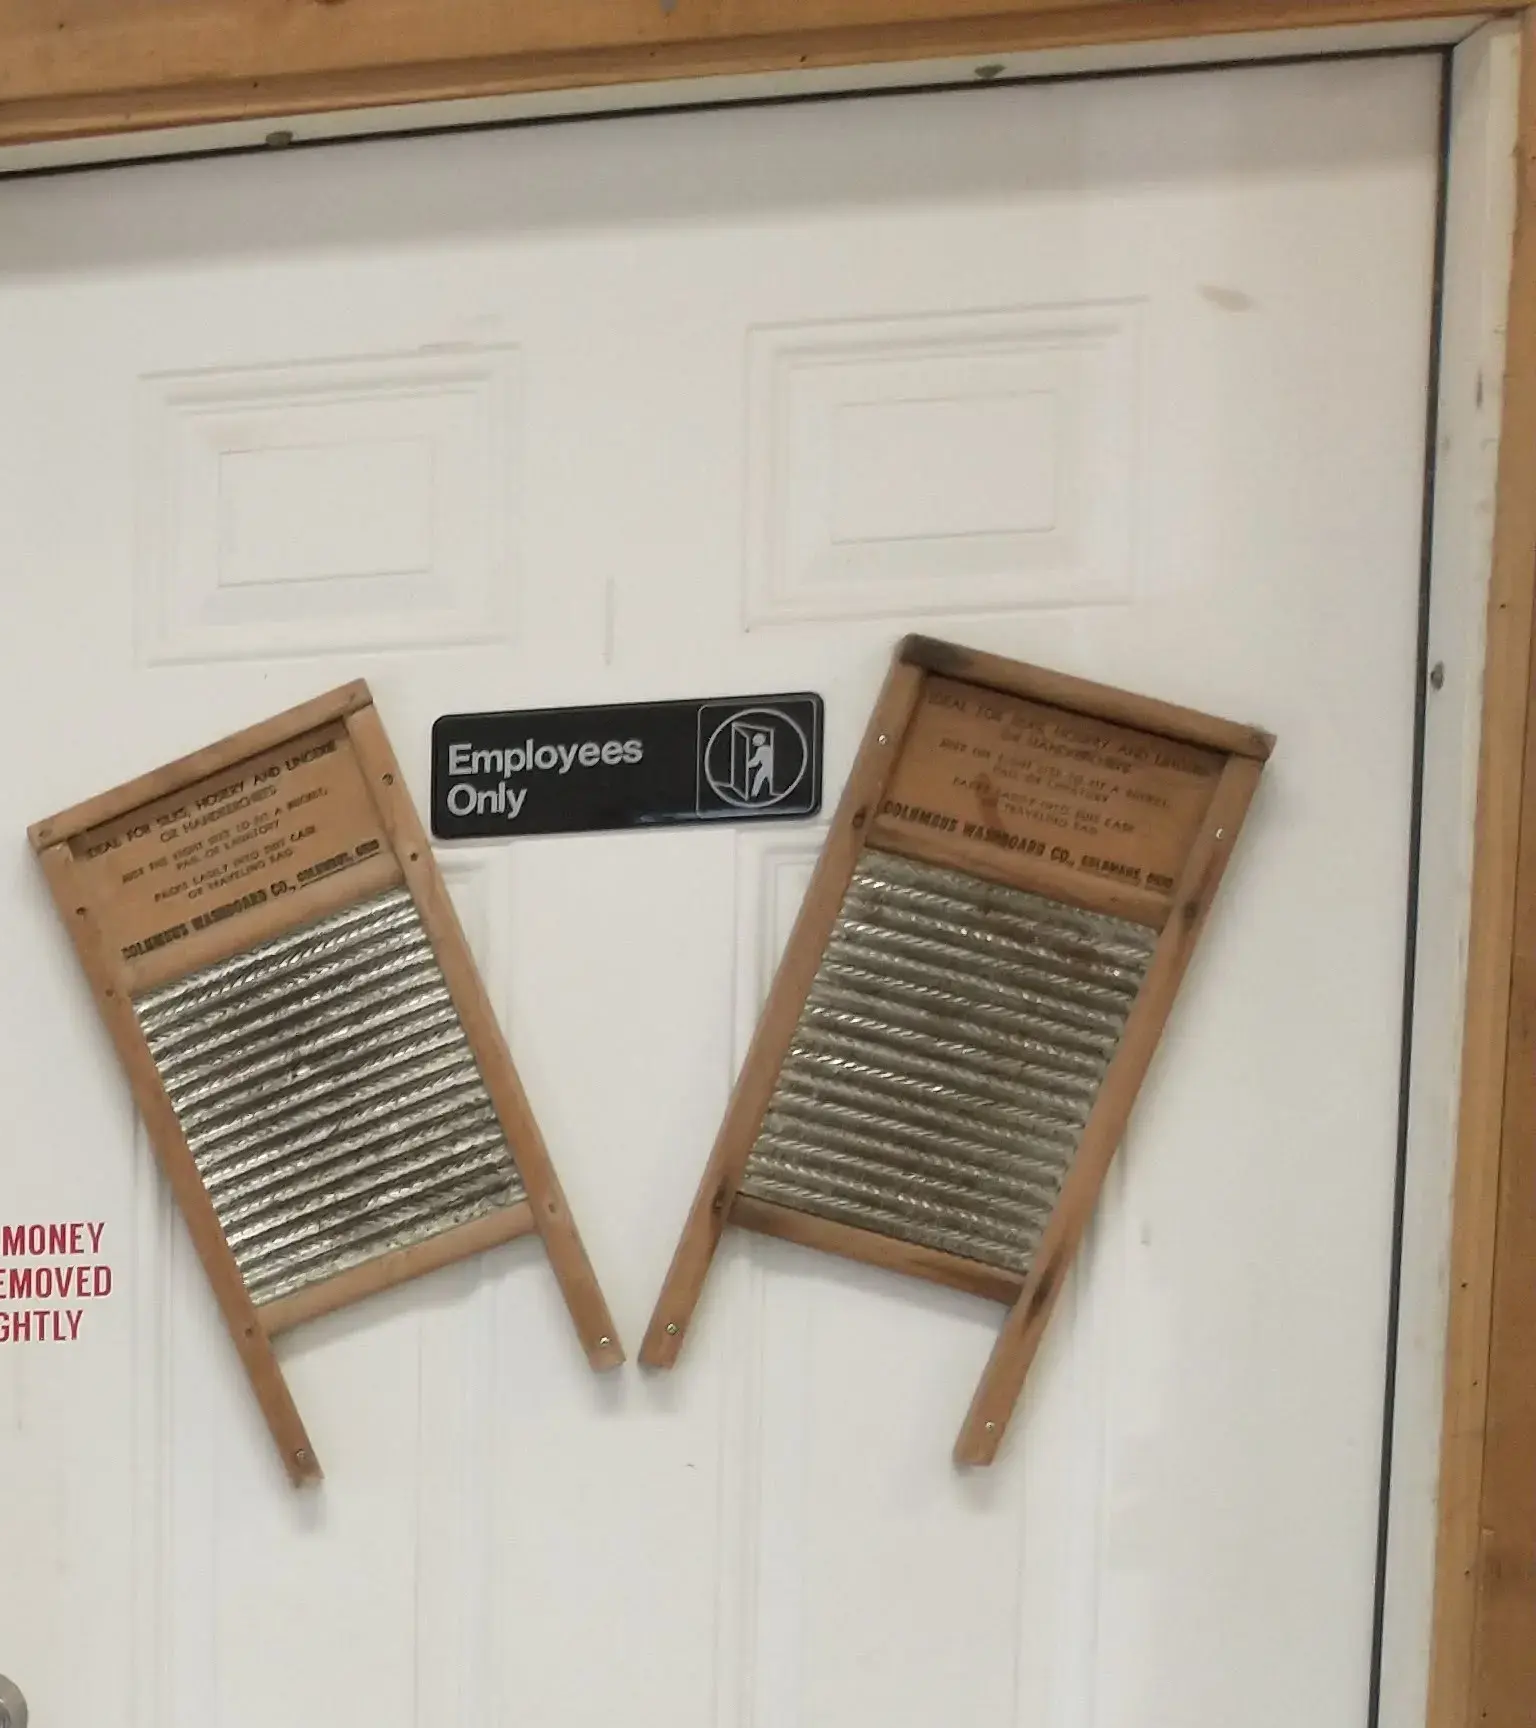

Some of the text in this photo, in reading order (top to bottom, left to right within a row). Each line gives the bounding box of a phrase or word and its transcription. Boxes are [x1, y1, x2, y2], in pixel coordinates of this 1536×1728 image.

[448, 738, 643, 779] Employees
[447, 781, 527, 819] Only
[3, 1222, 105, 1257] MONEY
